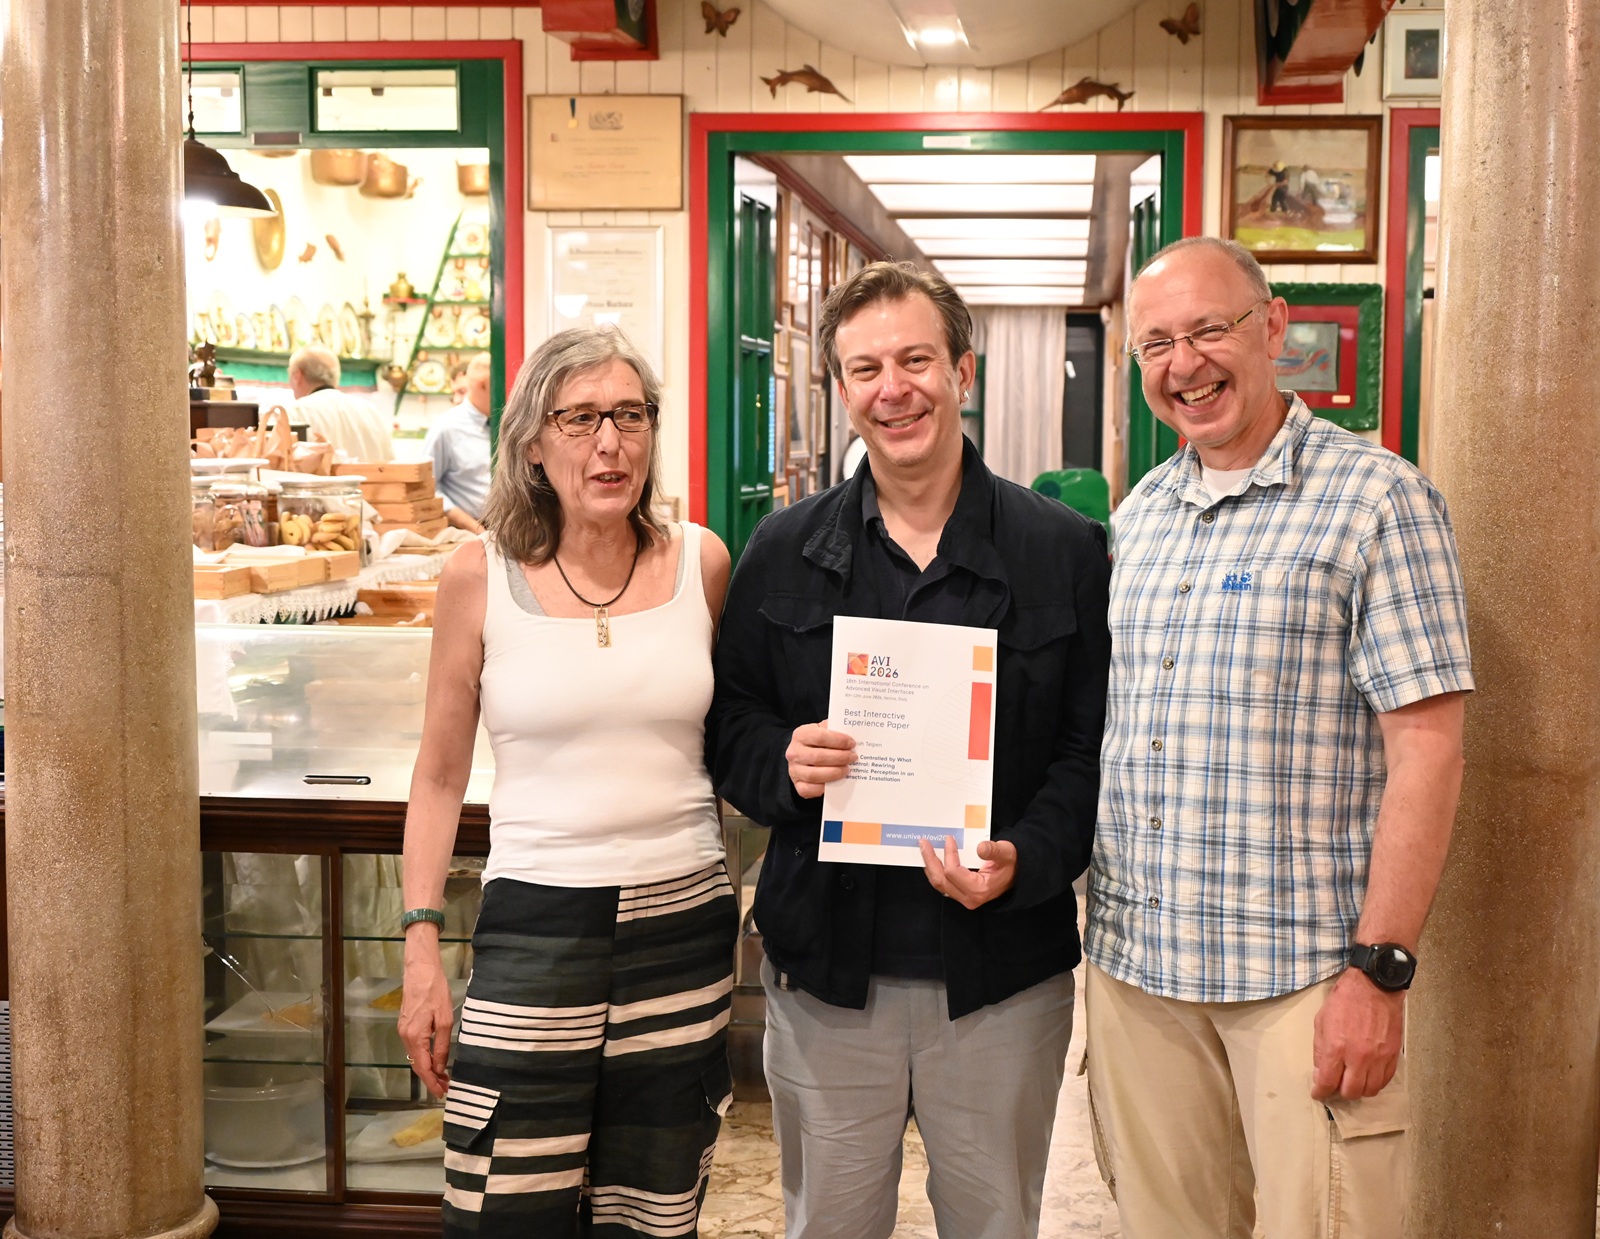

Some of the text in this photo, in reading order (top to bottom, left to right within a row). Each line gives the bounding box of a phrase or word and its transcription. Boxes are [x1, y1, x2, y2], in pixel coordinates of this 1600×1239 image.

[871, 656, 890, 666] AVI
[870, 666, 899, 678] 2026
[844, 708, 905, 720] Best Interactive
[843, 718, 910, 730] Experience Paper
